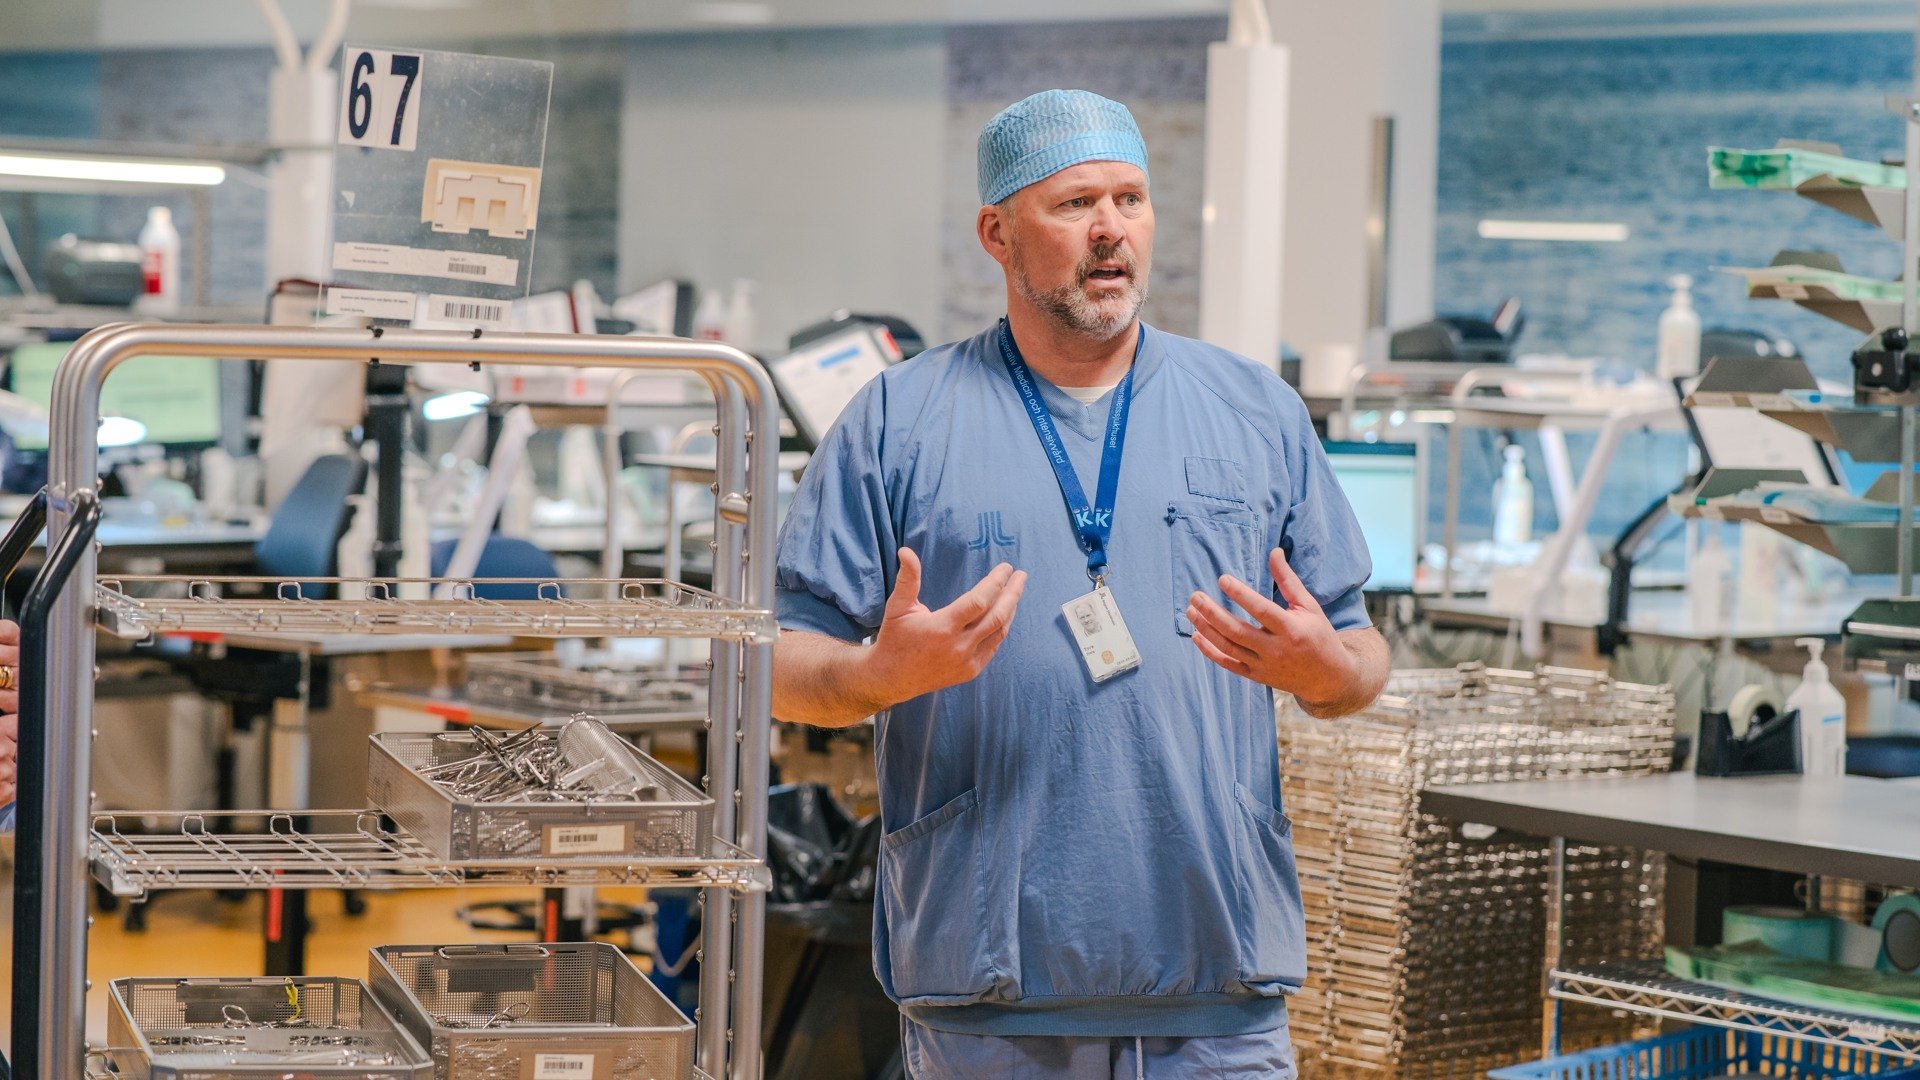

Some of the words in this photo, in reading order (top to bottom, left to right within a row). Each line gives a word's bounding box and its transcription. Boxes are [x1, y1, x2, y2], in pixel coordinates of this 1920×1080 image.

[348, 51, 420, 146] 67
[1013, 365, 1034, 398] Medicin
[1028, 398, 1041, 415] och
[1036, 414, 1066, 465] Intensivvård
